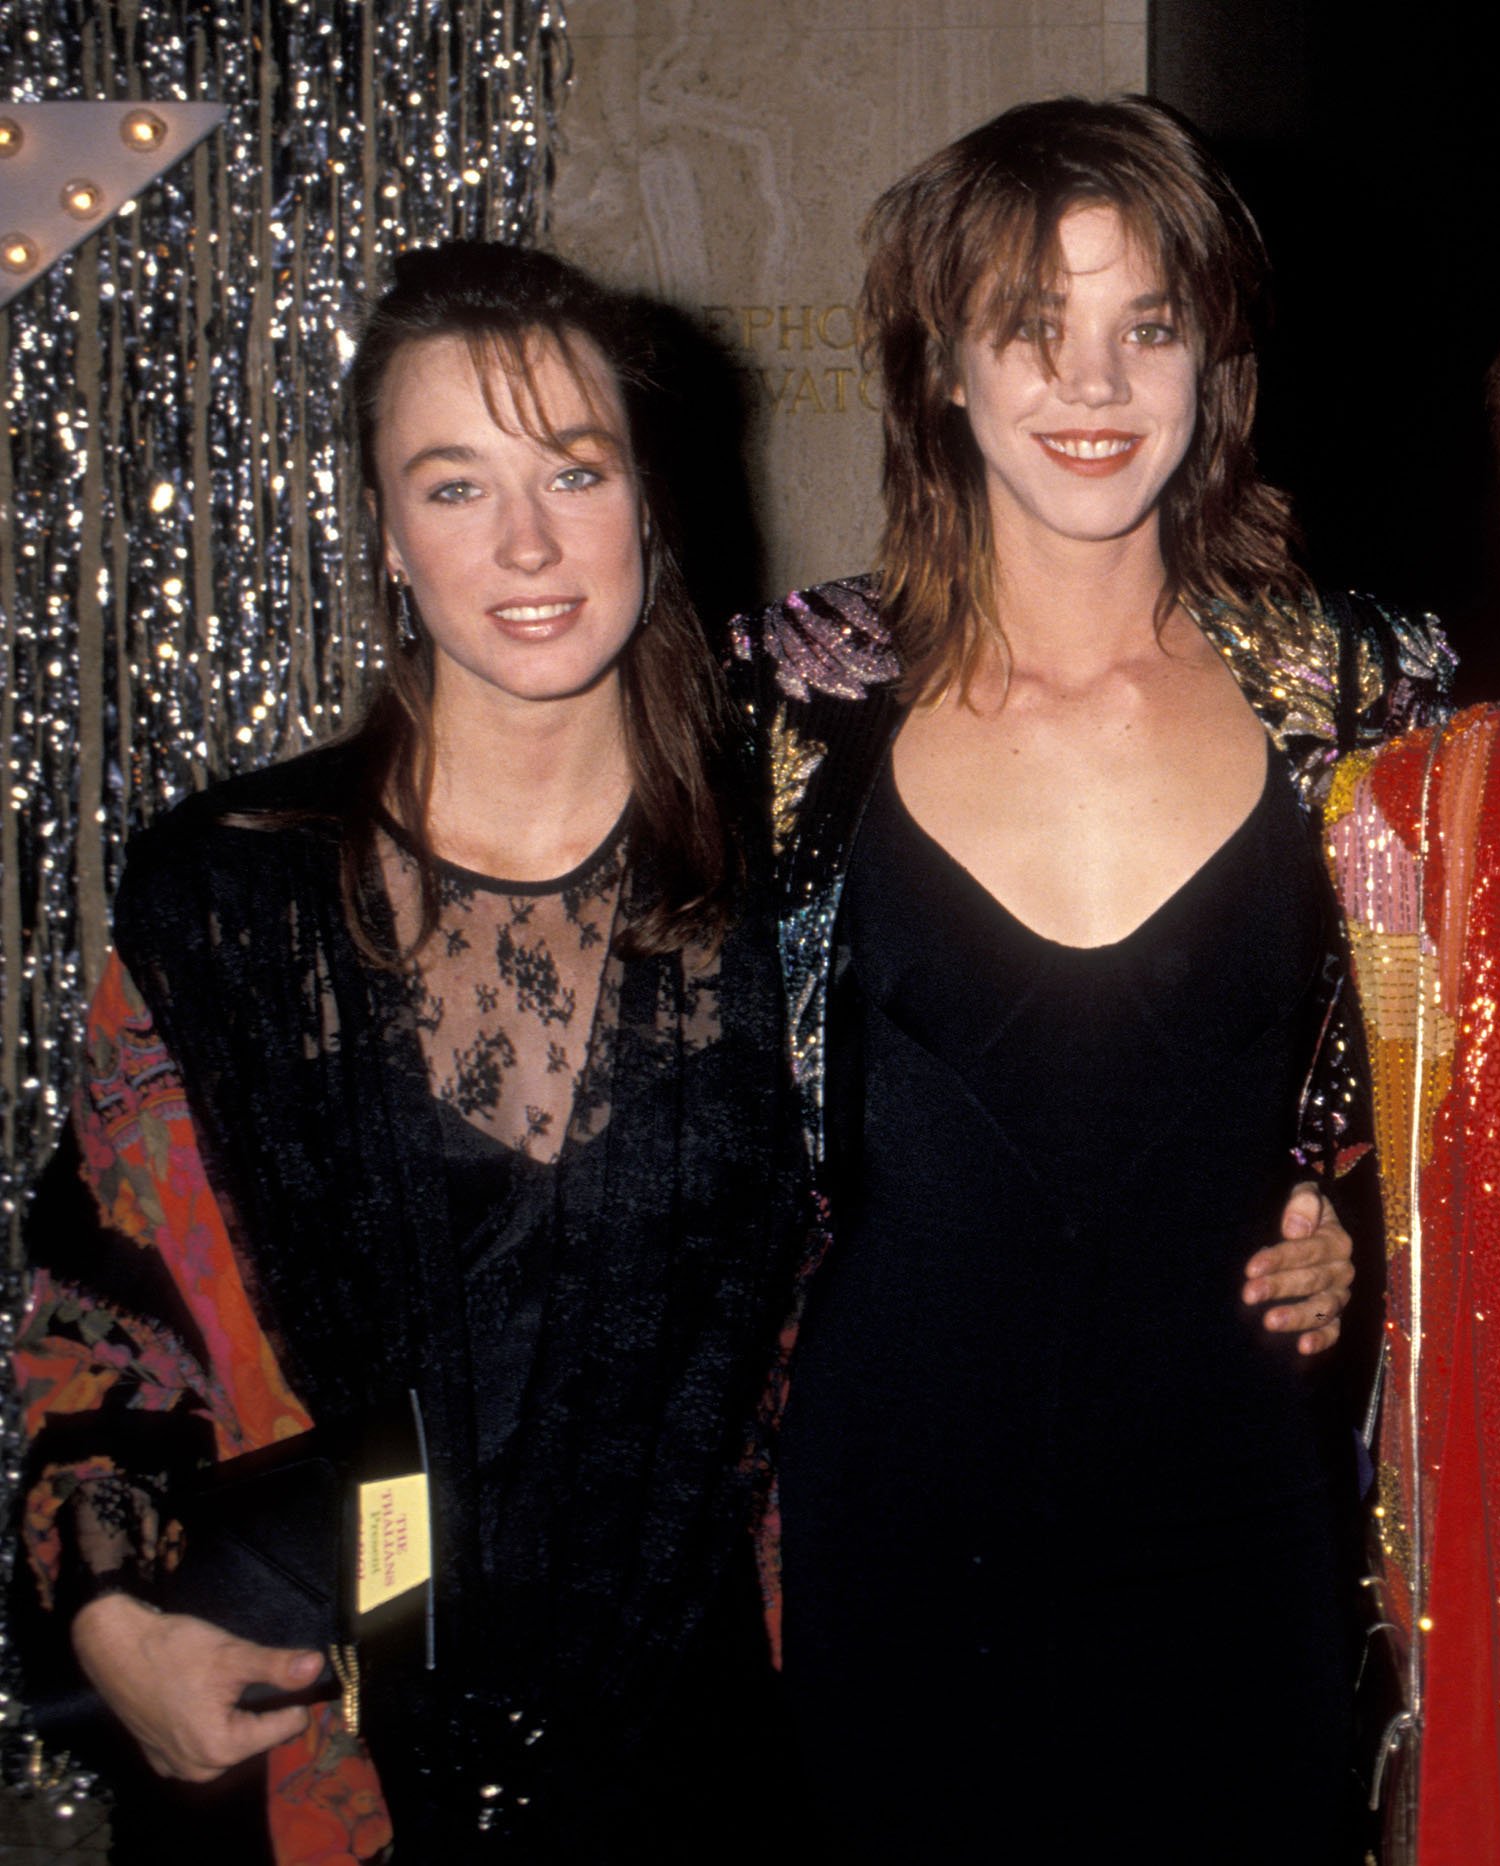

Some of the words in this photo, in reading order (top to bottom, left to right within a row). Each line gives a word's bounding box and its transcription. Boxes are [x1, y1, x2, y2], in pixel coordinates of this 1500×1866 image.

[370, 1511, 381, 1575] Present
[382, 1488, 395, 1587] THALIANS
[396, 1513, 407, 1554] THE
